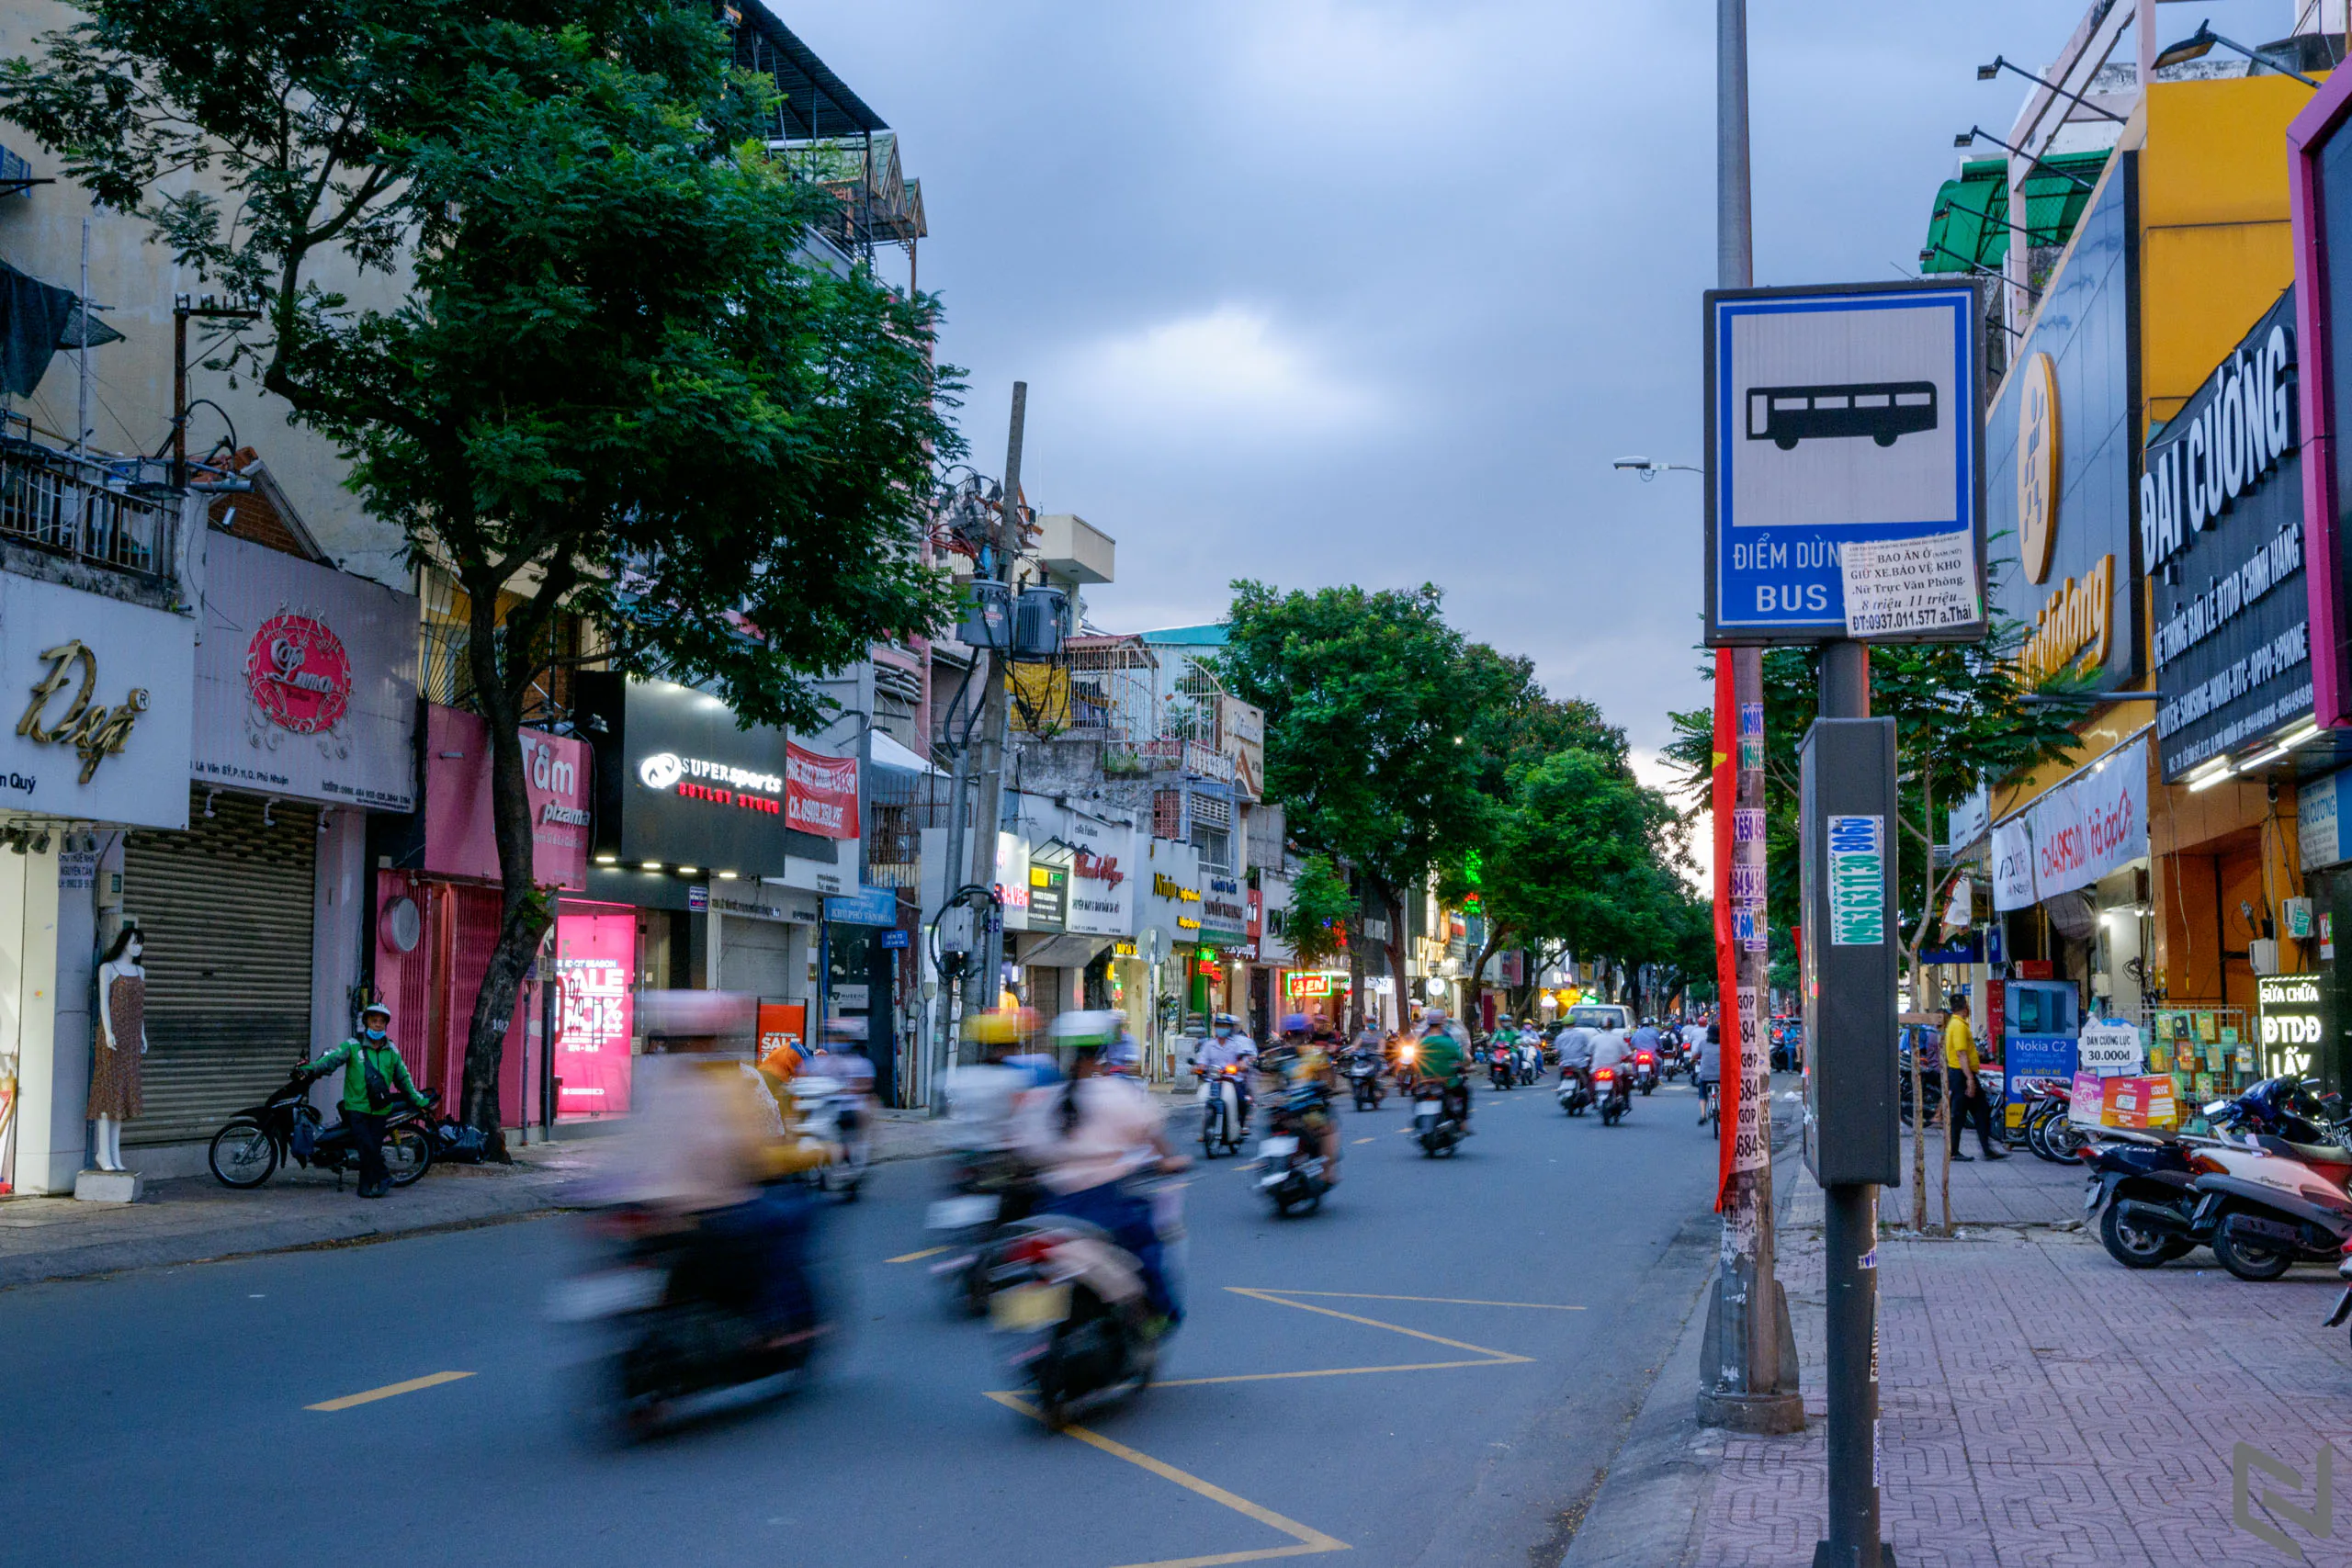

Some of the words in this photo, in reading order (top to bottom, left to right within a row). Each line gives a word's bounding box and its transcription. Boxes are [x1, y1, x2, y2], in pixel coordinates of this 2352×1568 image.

[2141, 441, 2184, 585] ĐẠI
[1733, 532, 1787, 570] ĐIỂM
[1796, 535, 1842, 570] DỪN
[1878, 552, 1901, 563] BAO
[1904, 549, 1919, 560] ĂN
[1918, 563, 1933, 575] VỆ
[1937, 559, 1962, 571] KHO
[1874, 583, 1901, 595] Trực
[1904, 581, 1925, 591] Văn
[1756, 585, 1827, 612] BUS
[1873, 598, 1902, 612] triệu
[1928, 592, 1957, 605] triệu
[2164, 603, 2187, 661] THỐNG
[2188, 593, 2205, 647] BÁN
[2217, 571, 2240, 625] ĐTDĐ
[2242, 545, 2269, 605] CHÍNH
[1940, 604, 1973, 623] a.Thái
[10, 773, 36, 795] Quý
[681, 757, 781, 793] SUPERsports
[679, 782, 731, 804] OUTLET
[543, 799, 591, 826] pizama
[1839, 855, 1883, 943] 0963.63.11.30
[831, 908, 847, 919] KHU
[1737, 992, 1755, 1010] GÓP
[2262, 984, 2285, 1002] SỬA
[2287, 982, 2319, 1002] CHỮA
[1740, 1020, 1756, 1043] 84
[2264, 1016, 2322, 1043] ĐTDĐ
[762, 1037, 800, 1050] SAL
[2016, 1040, 2048, 1052] Nokia
[2052, 1041, 2067, 1052] C2
[1741, 1050, 1758, 1067] GÓP
[2088, 1050, 2131, 1061] 30.000đ
[1738, 1106, 1757, 1123] GÓP
